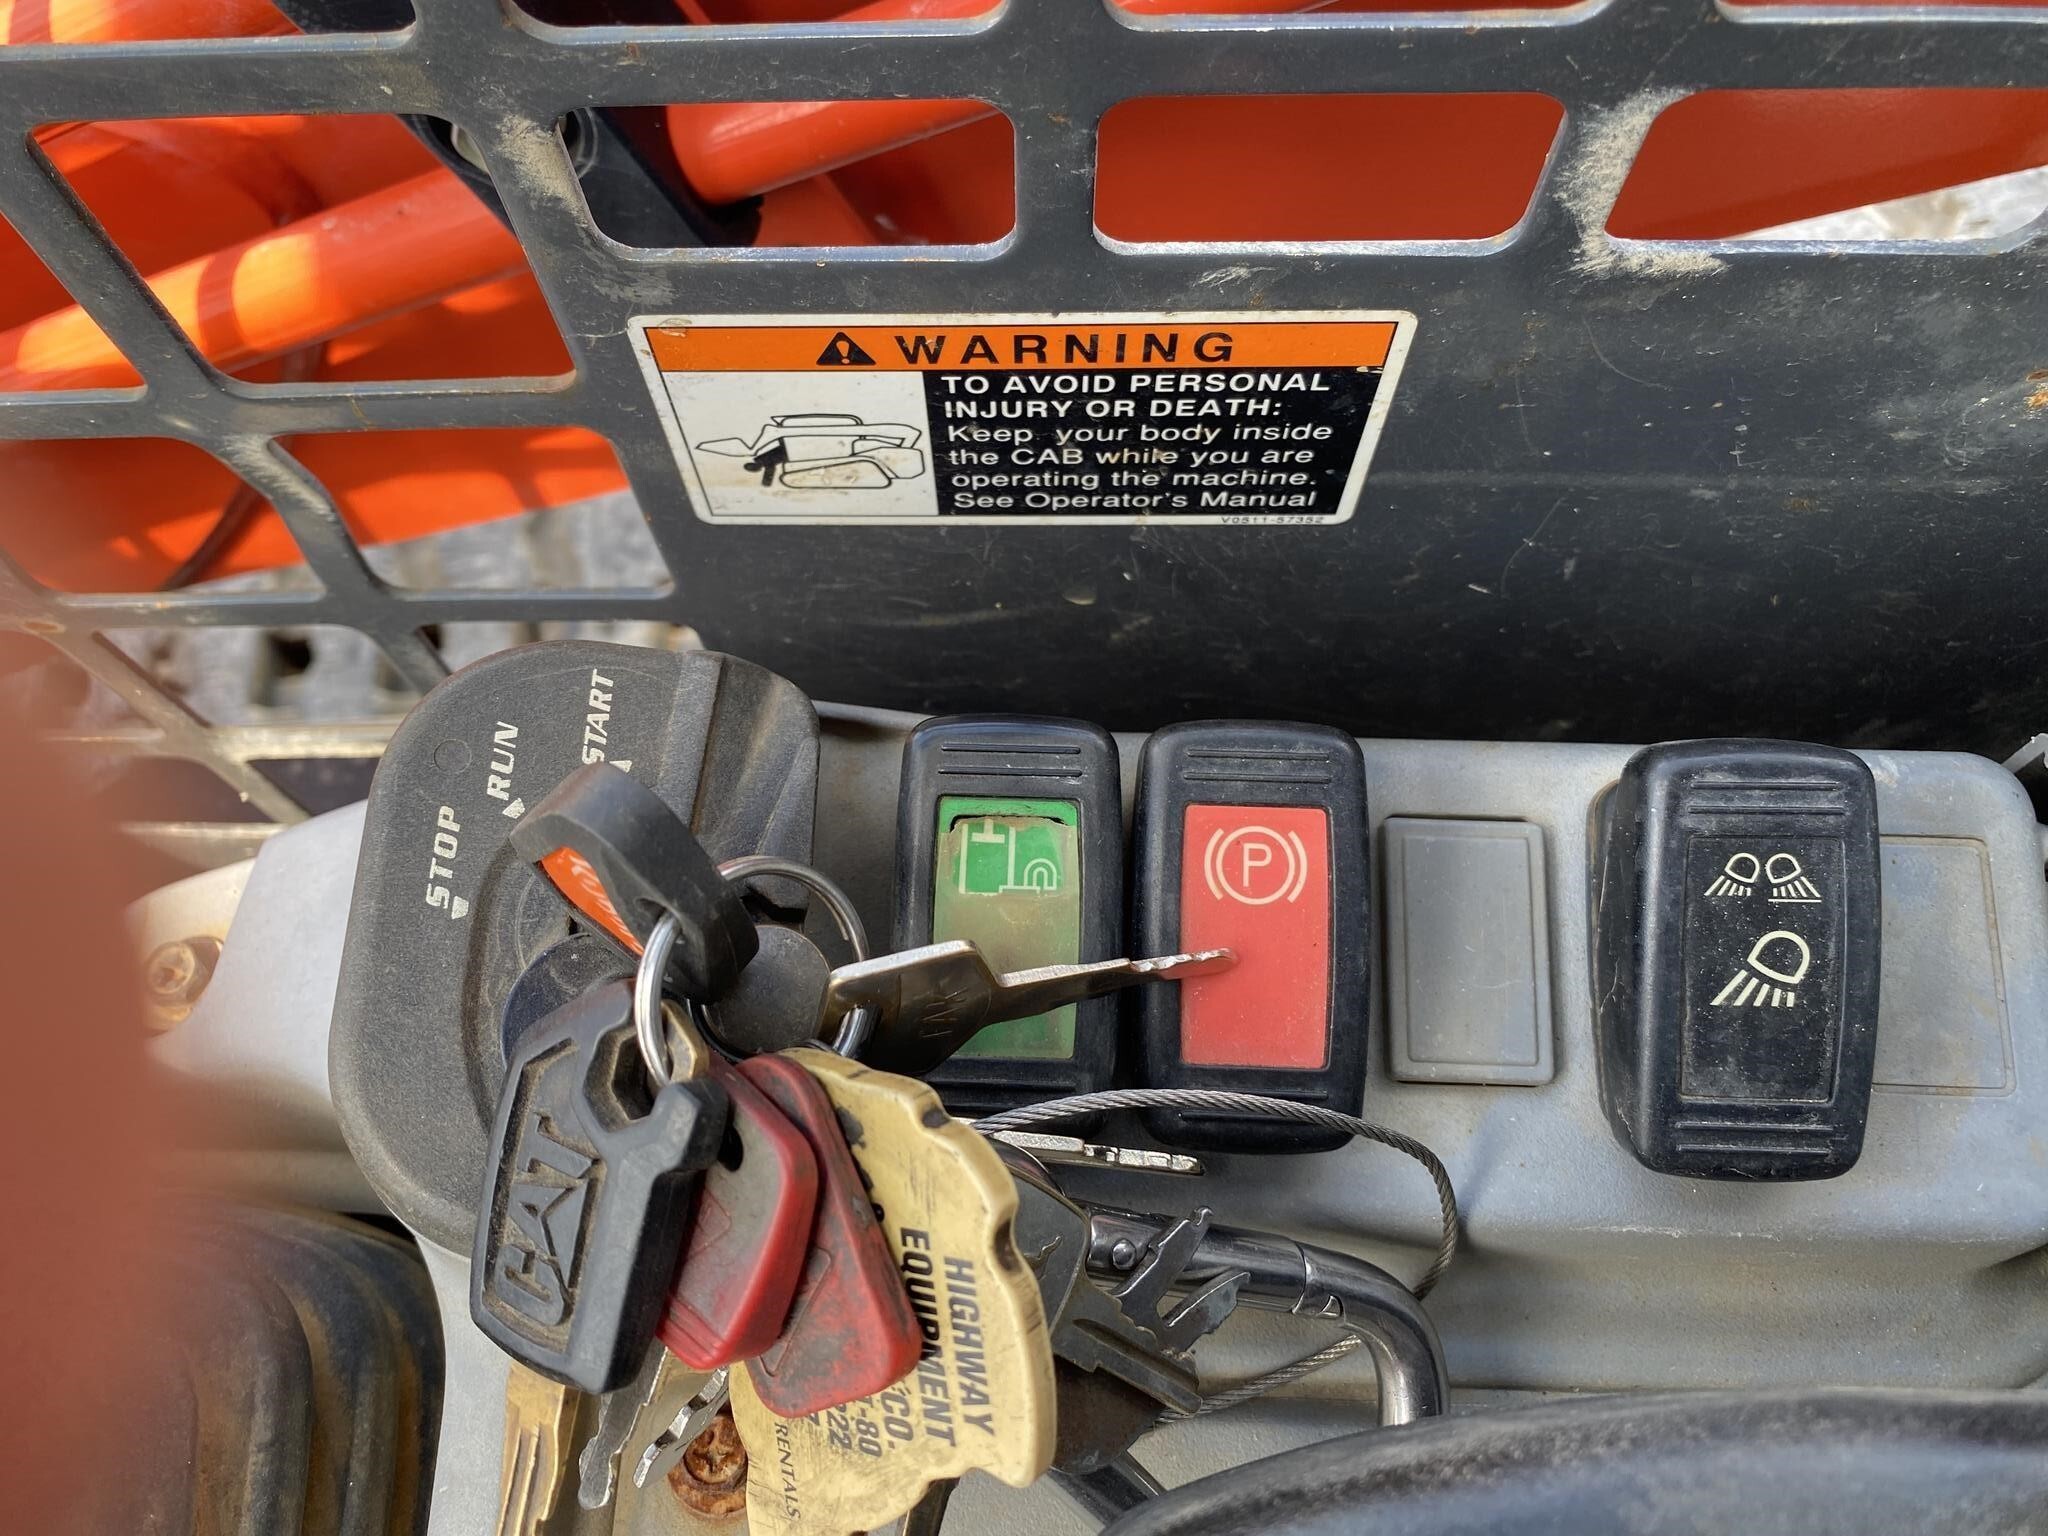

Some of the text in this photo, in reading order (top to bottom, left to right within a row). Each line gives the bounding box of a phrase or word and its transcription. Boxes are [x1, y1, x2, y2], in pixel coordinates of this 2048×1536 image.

[895, 332, 1233, 364] WARNING
[941, 373, 1330, 394] TO AVOID PERSONAL
[945, 398, 1282, 418] INJURY OR DEATH:
[948, 423, 1333, 446] Keep your body inside
[949, 448, 1314, 468] the CAB while you are
[952, 470, 1317, 490] operating the machine.
[954, 491, 1319, 511] See Operator's Manual
[581, 668, 614, 765] START
[486, 720, 519, 801] RUN
[425, 805, 461, 909] STOP
[1242, 842, 1272, 887] P
[497, 1108, 605, 1328] CAT
[900, 1226, 957, 1447] EQUIPMENT
[944, 1255, 996, 1436] HIGHWAY
[774, 1421, 800, 1519] RENTALS
